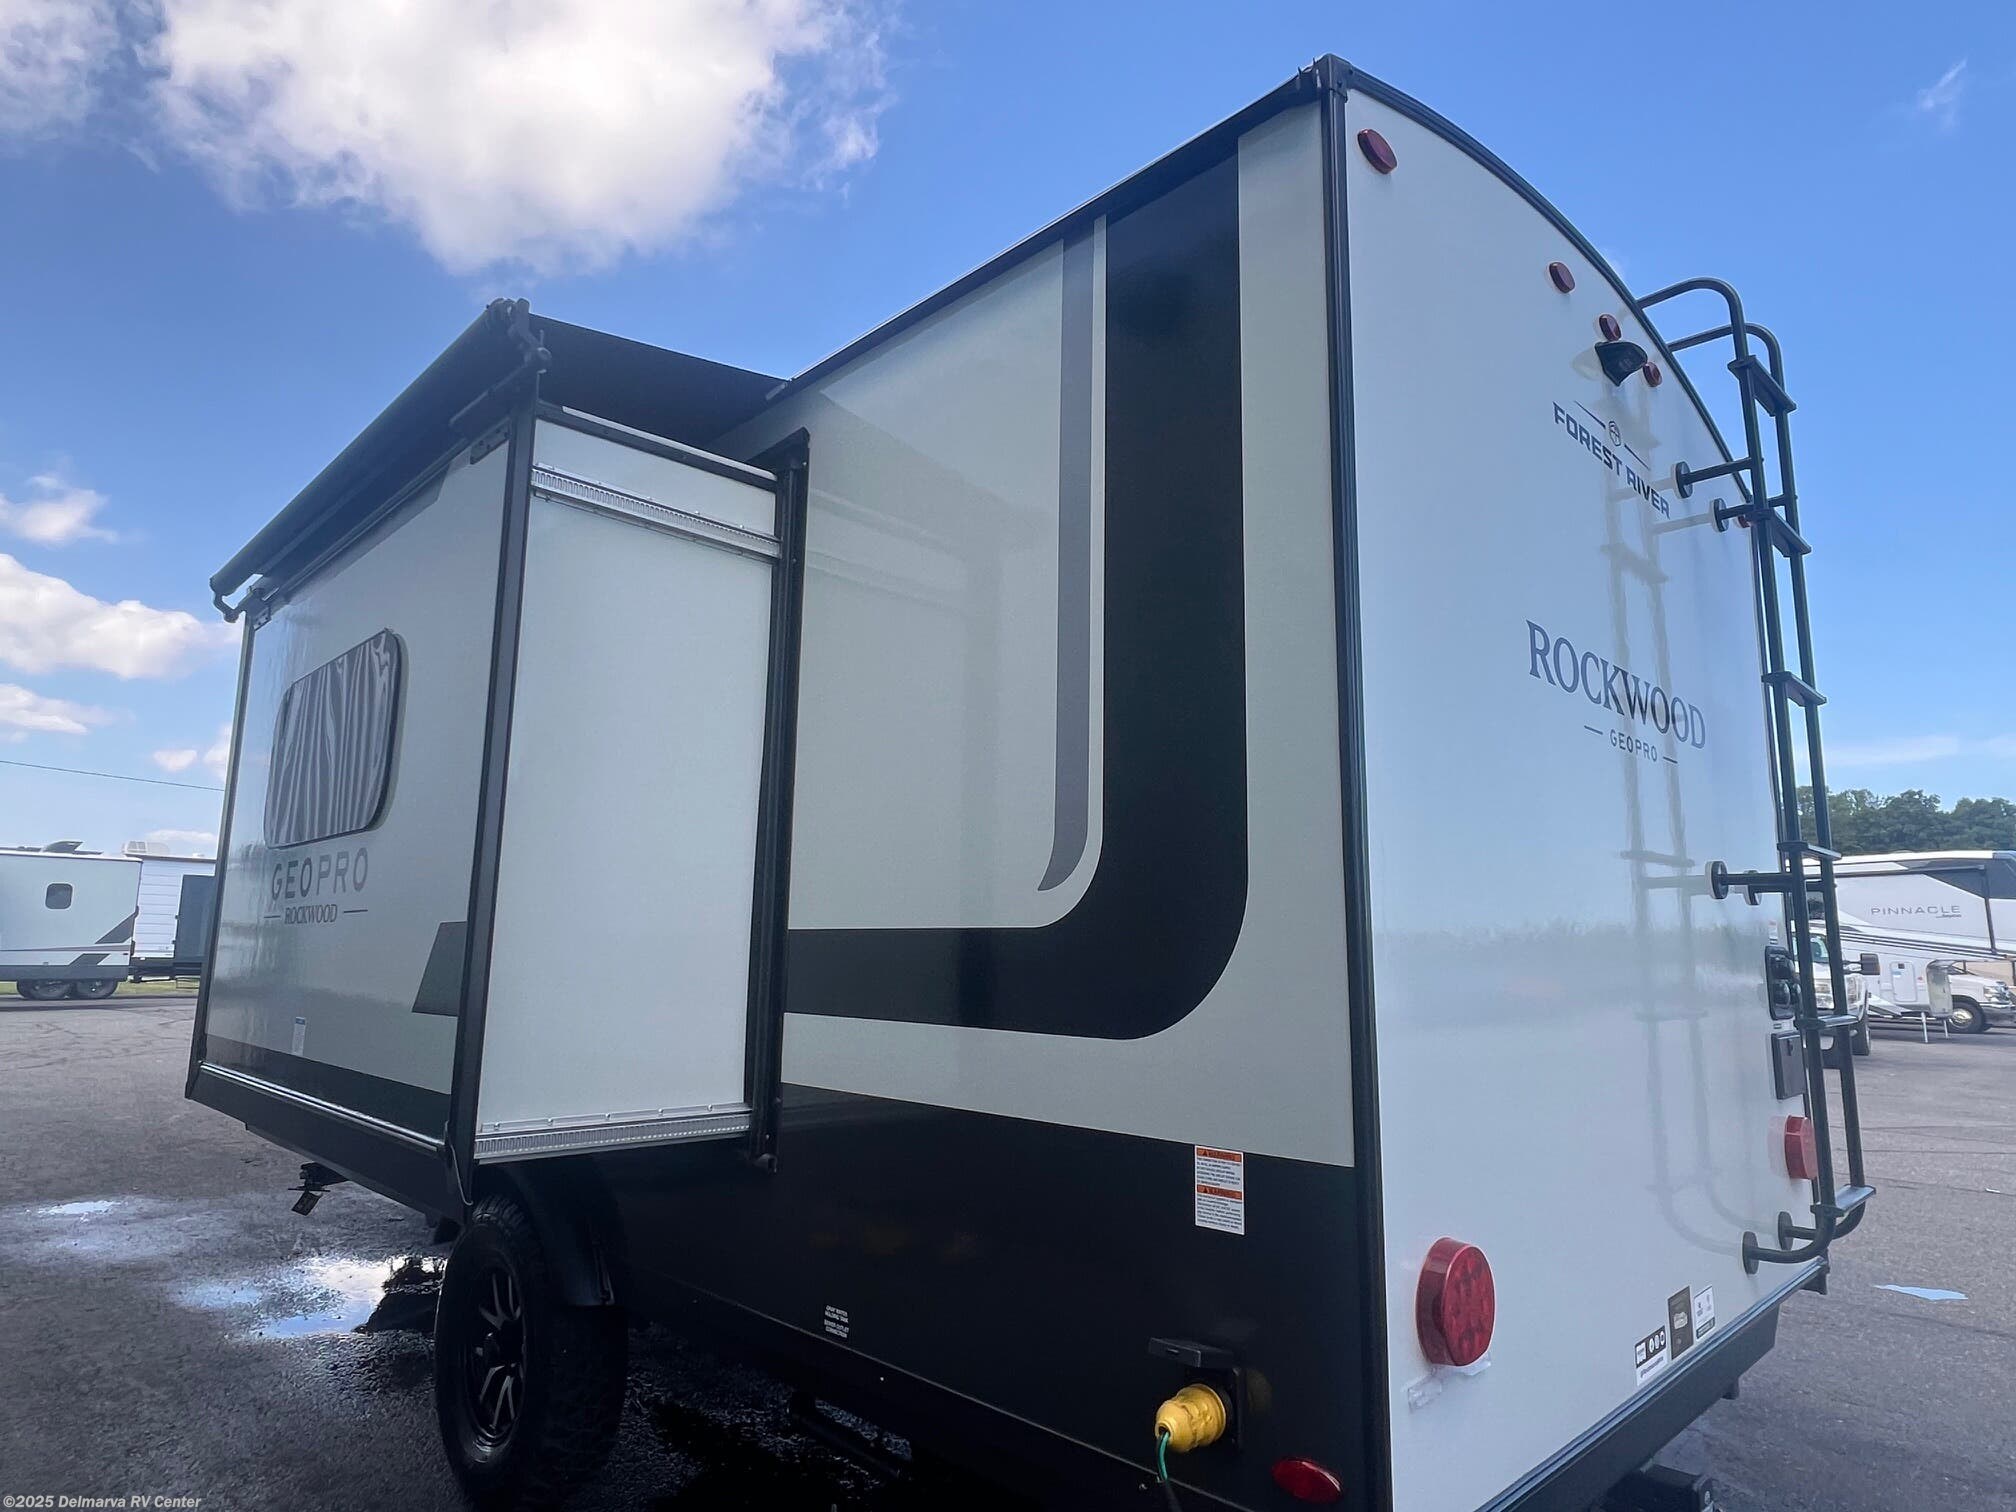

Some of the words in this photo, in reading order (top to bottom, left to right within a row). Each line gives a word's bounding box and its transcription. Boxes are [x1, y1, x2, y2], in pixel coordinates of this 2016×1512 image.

[1552, 400, 1623, 477] FOREST
[1625, 465, 1671, 520] RIVER
[1526, 619, 1707, 750] ROCKWOOD
[1609, 728, 1658, 763] GEOPRO
[271, 847, 369, 901] GEOPRO
[284, 903, 338, 925] ROCKWOOD
[1870, 905, 1961, 916] PINNACLE
